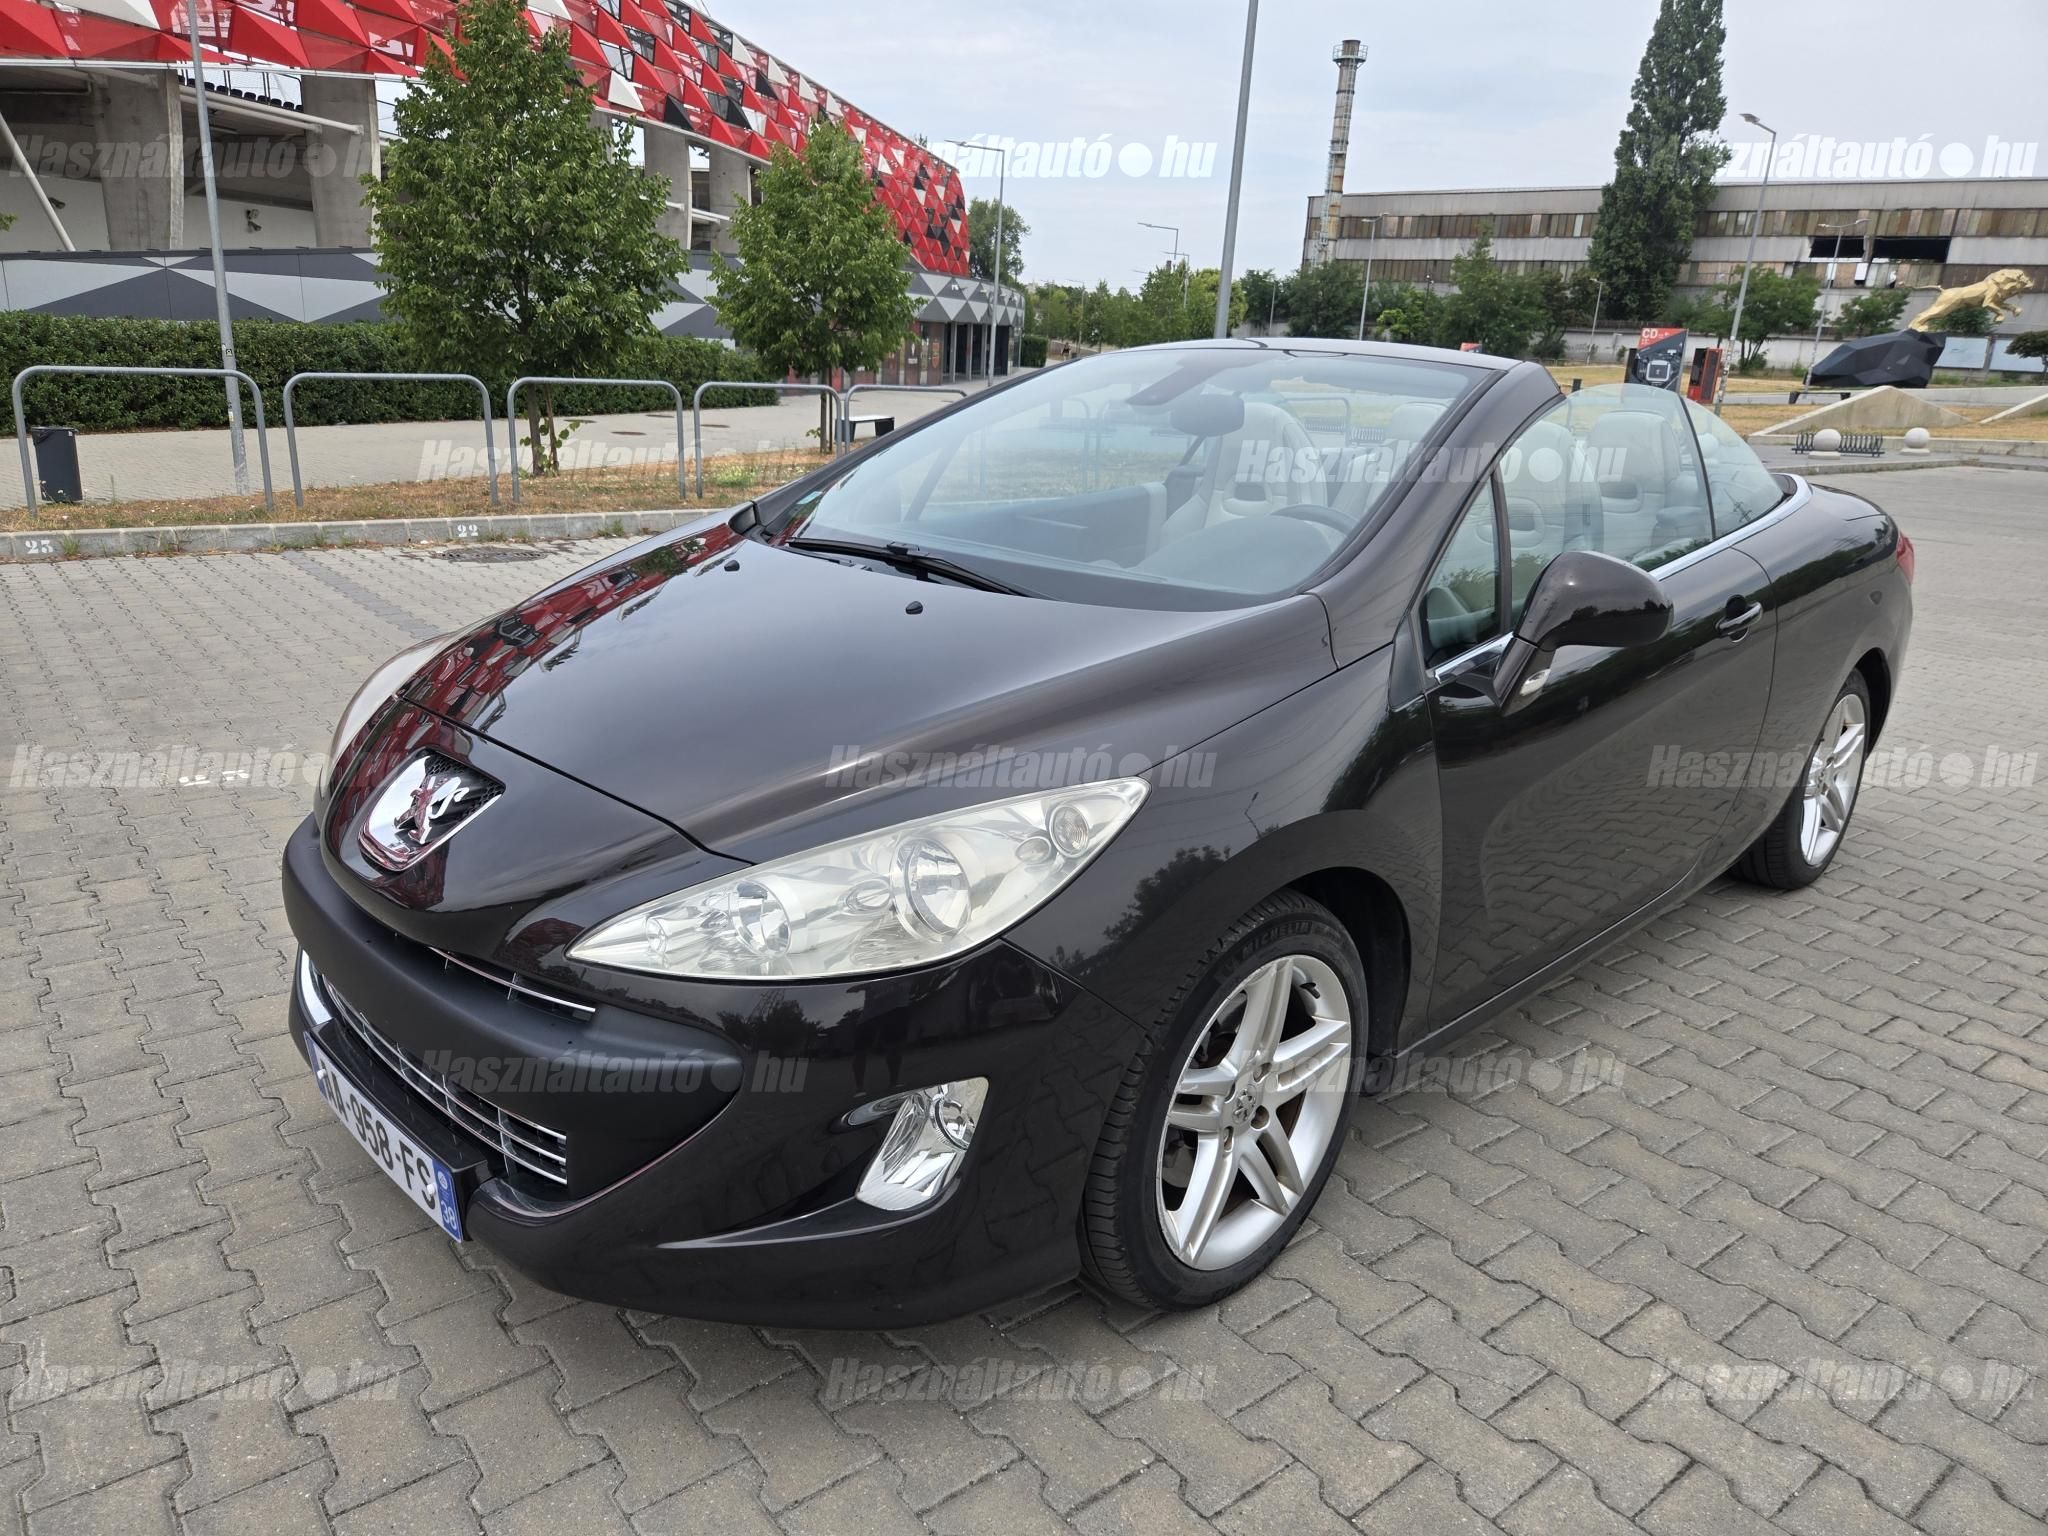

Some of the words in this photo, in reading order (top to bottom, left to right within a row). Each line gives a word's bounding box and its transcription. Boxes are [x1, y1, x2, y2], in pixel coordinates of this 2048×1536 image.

[1642, 328, 1658, 339] CD
[457, 524, 479, 537] 22
[440, 1200, 457, 1230] 38
